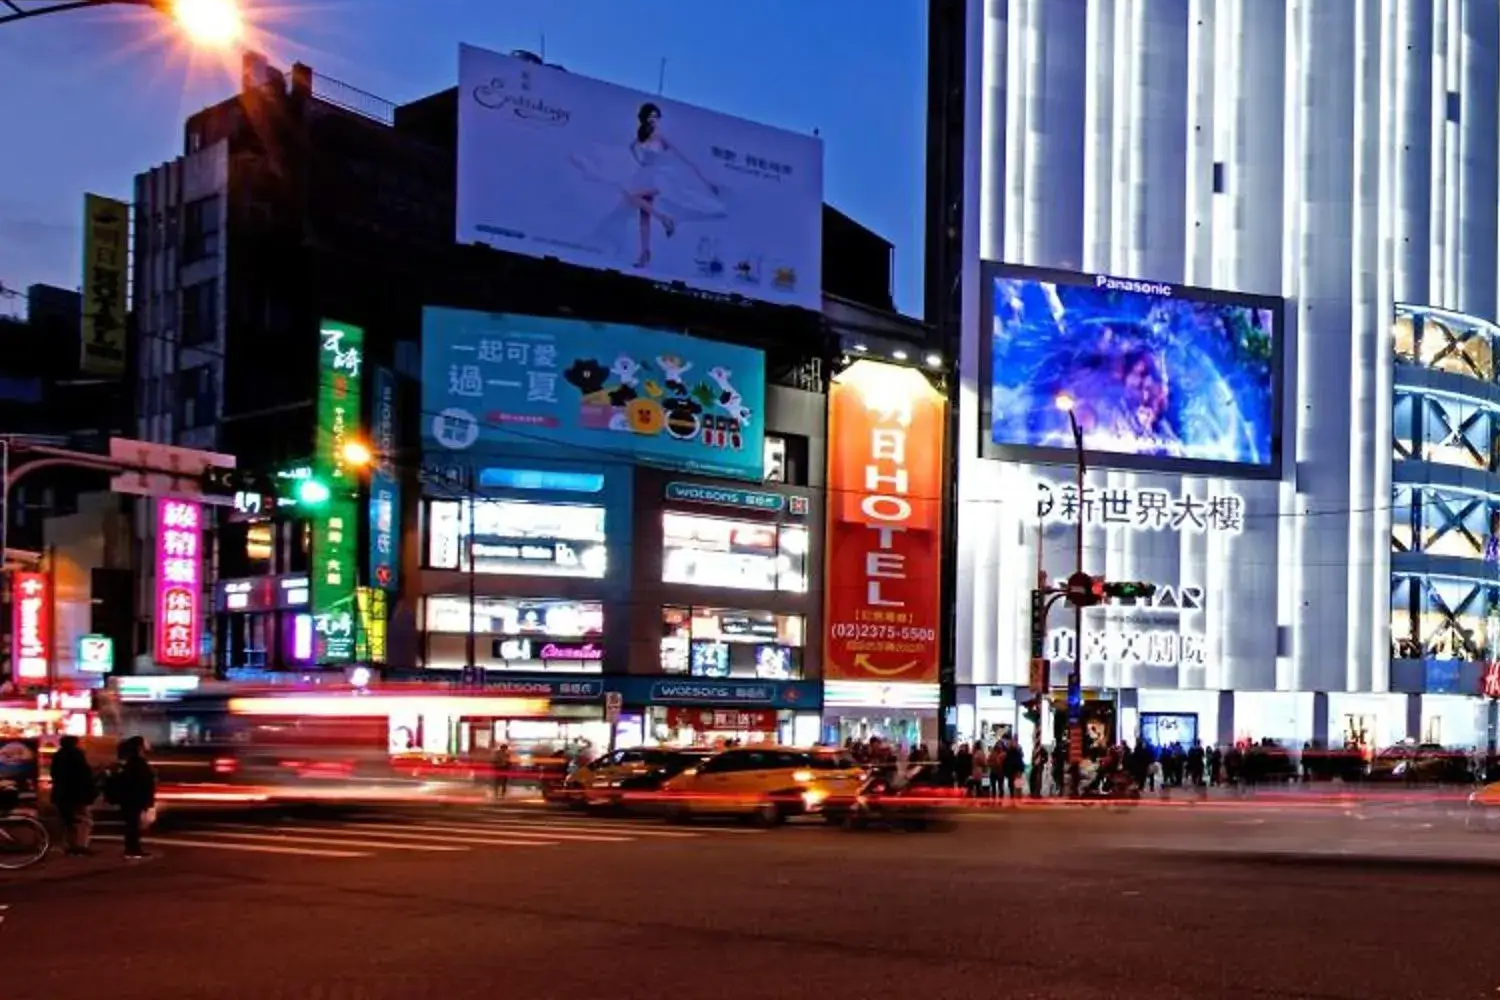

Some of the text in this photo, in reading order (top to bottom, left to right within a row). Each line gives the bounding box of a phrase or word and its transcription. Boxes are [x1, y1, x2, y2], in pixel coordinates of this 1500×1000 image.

[1096, 275, 1172, 297] Panasonic
[451, 338, 556, 367] 一起可愛
[448, 364, 558, 402] 過一夏
[675, 486, 738, 503] watsons
[861, 465, 912, 606] HOTEL
[831, 623, 935, 640] (02)2375-5500
[661, 686, 729, 697] watsons
